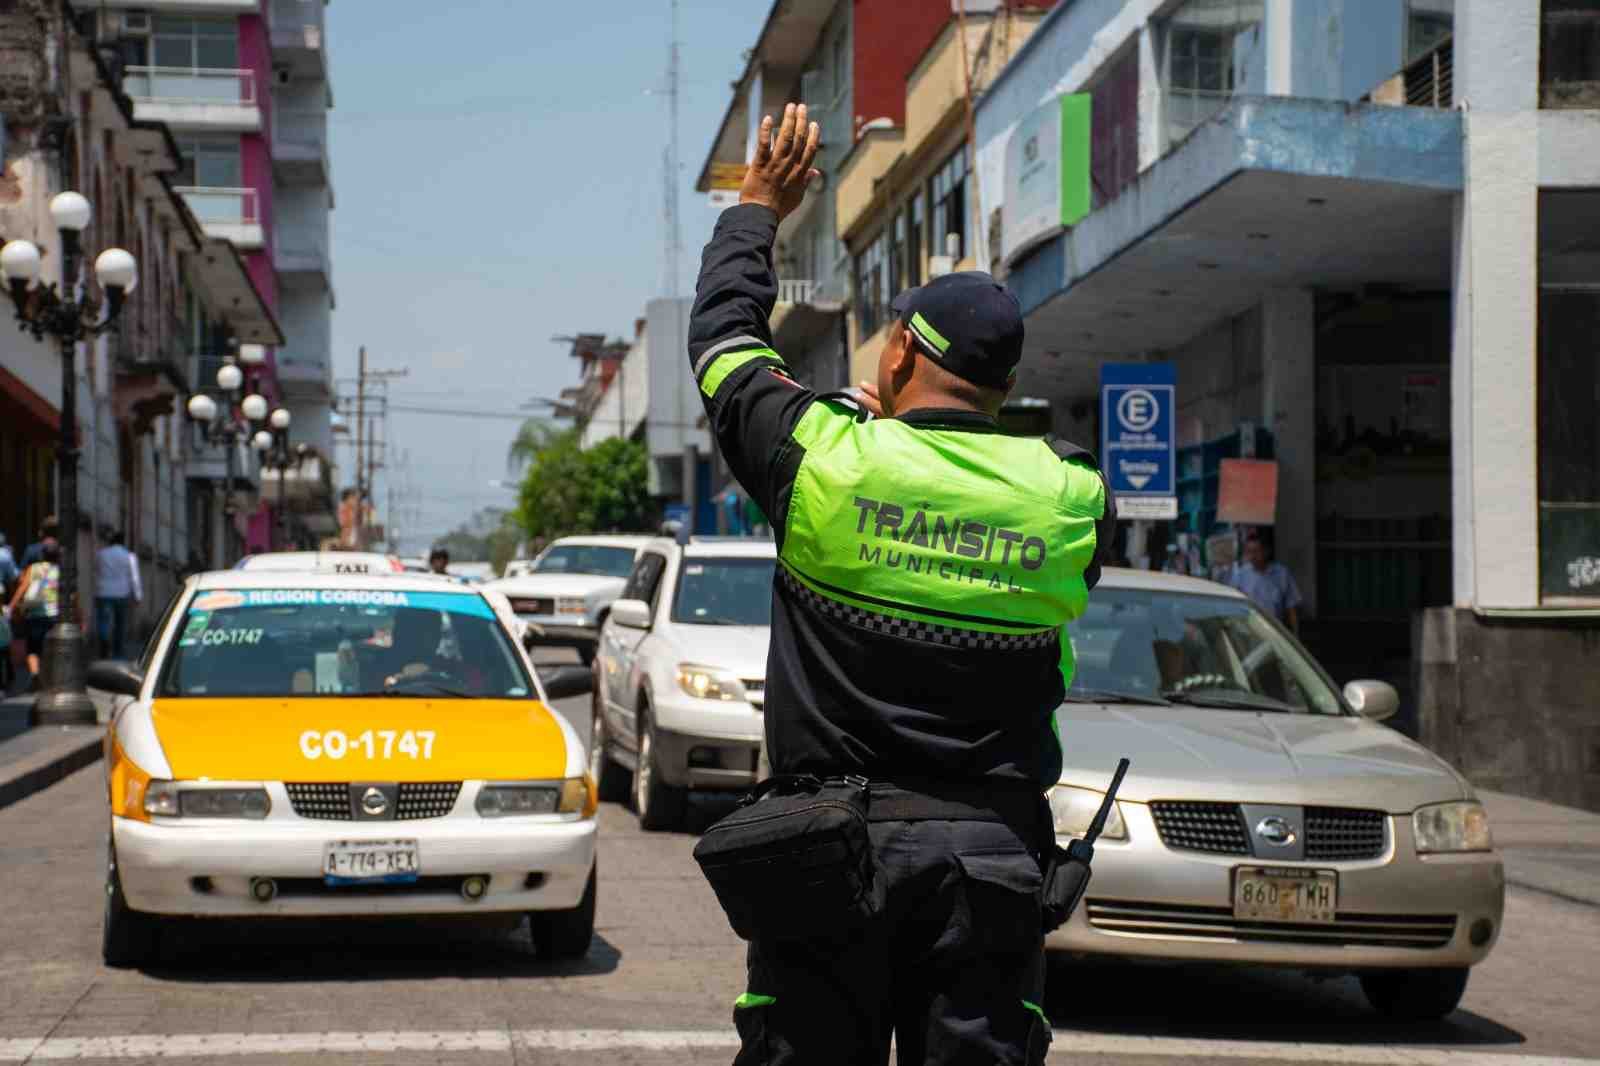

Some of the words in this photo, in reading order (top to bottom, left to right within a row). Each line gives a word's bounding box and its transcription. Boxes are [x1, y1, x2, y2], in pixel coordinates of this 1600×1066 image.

[1127, 397, 1148, 423] E
[335, 563, 369, 574] TAXI
[859, 543, 1023, 593] MUNICIPAL
[250, 591, 317, 605] REGION
[321, 591, 408, 606] CORDOBA
[202, 629, 264, 646] CO-1747
[299, 729, 436, 760] CO-1747
[328, 850, 415, 872] A-774-XEX
